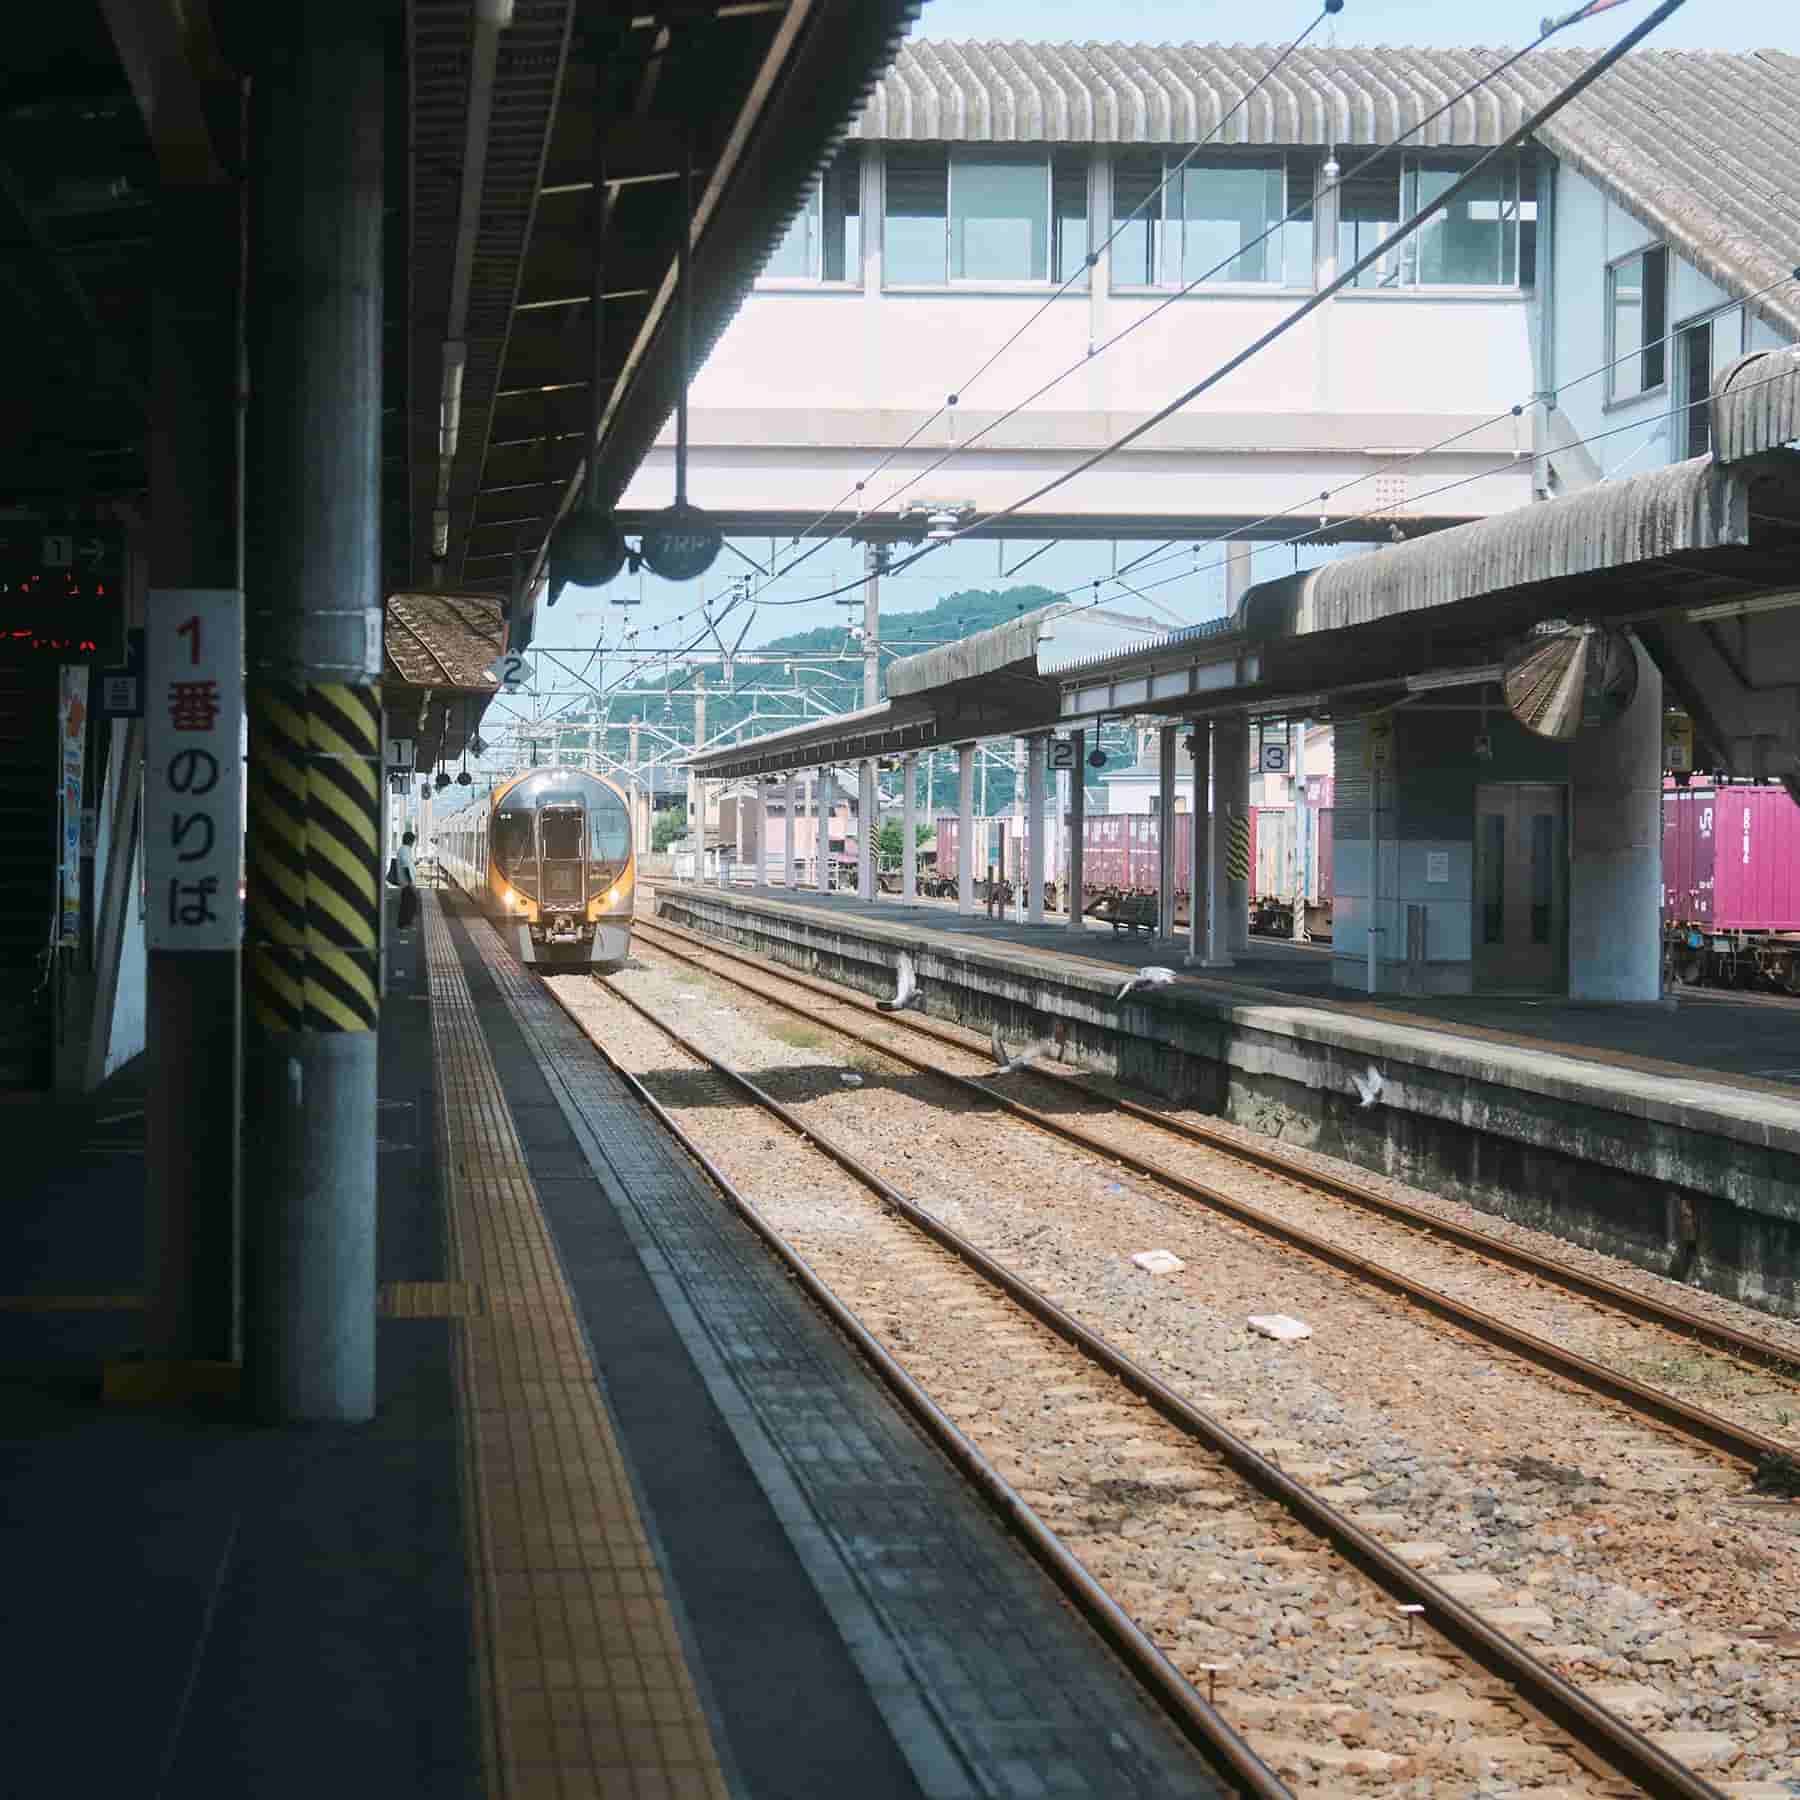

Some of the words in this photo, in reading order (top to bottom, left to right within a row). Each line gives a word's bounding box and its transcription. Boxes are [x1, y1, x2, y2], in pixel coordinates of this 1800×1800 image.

[503, 657, 522, 684] 2
[391, 742, 402, 763] 1
[1055, 743, 1073, 766] 2
[1265, 747, 1285, 769] 3
[168, 616, 220, 926] 1番のりば
